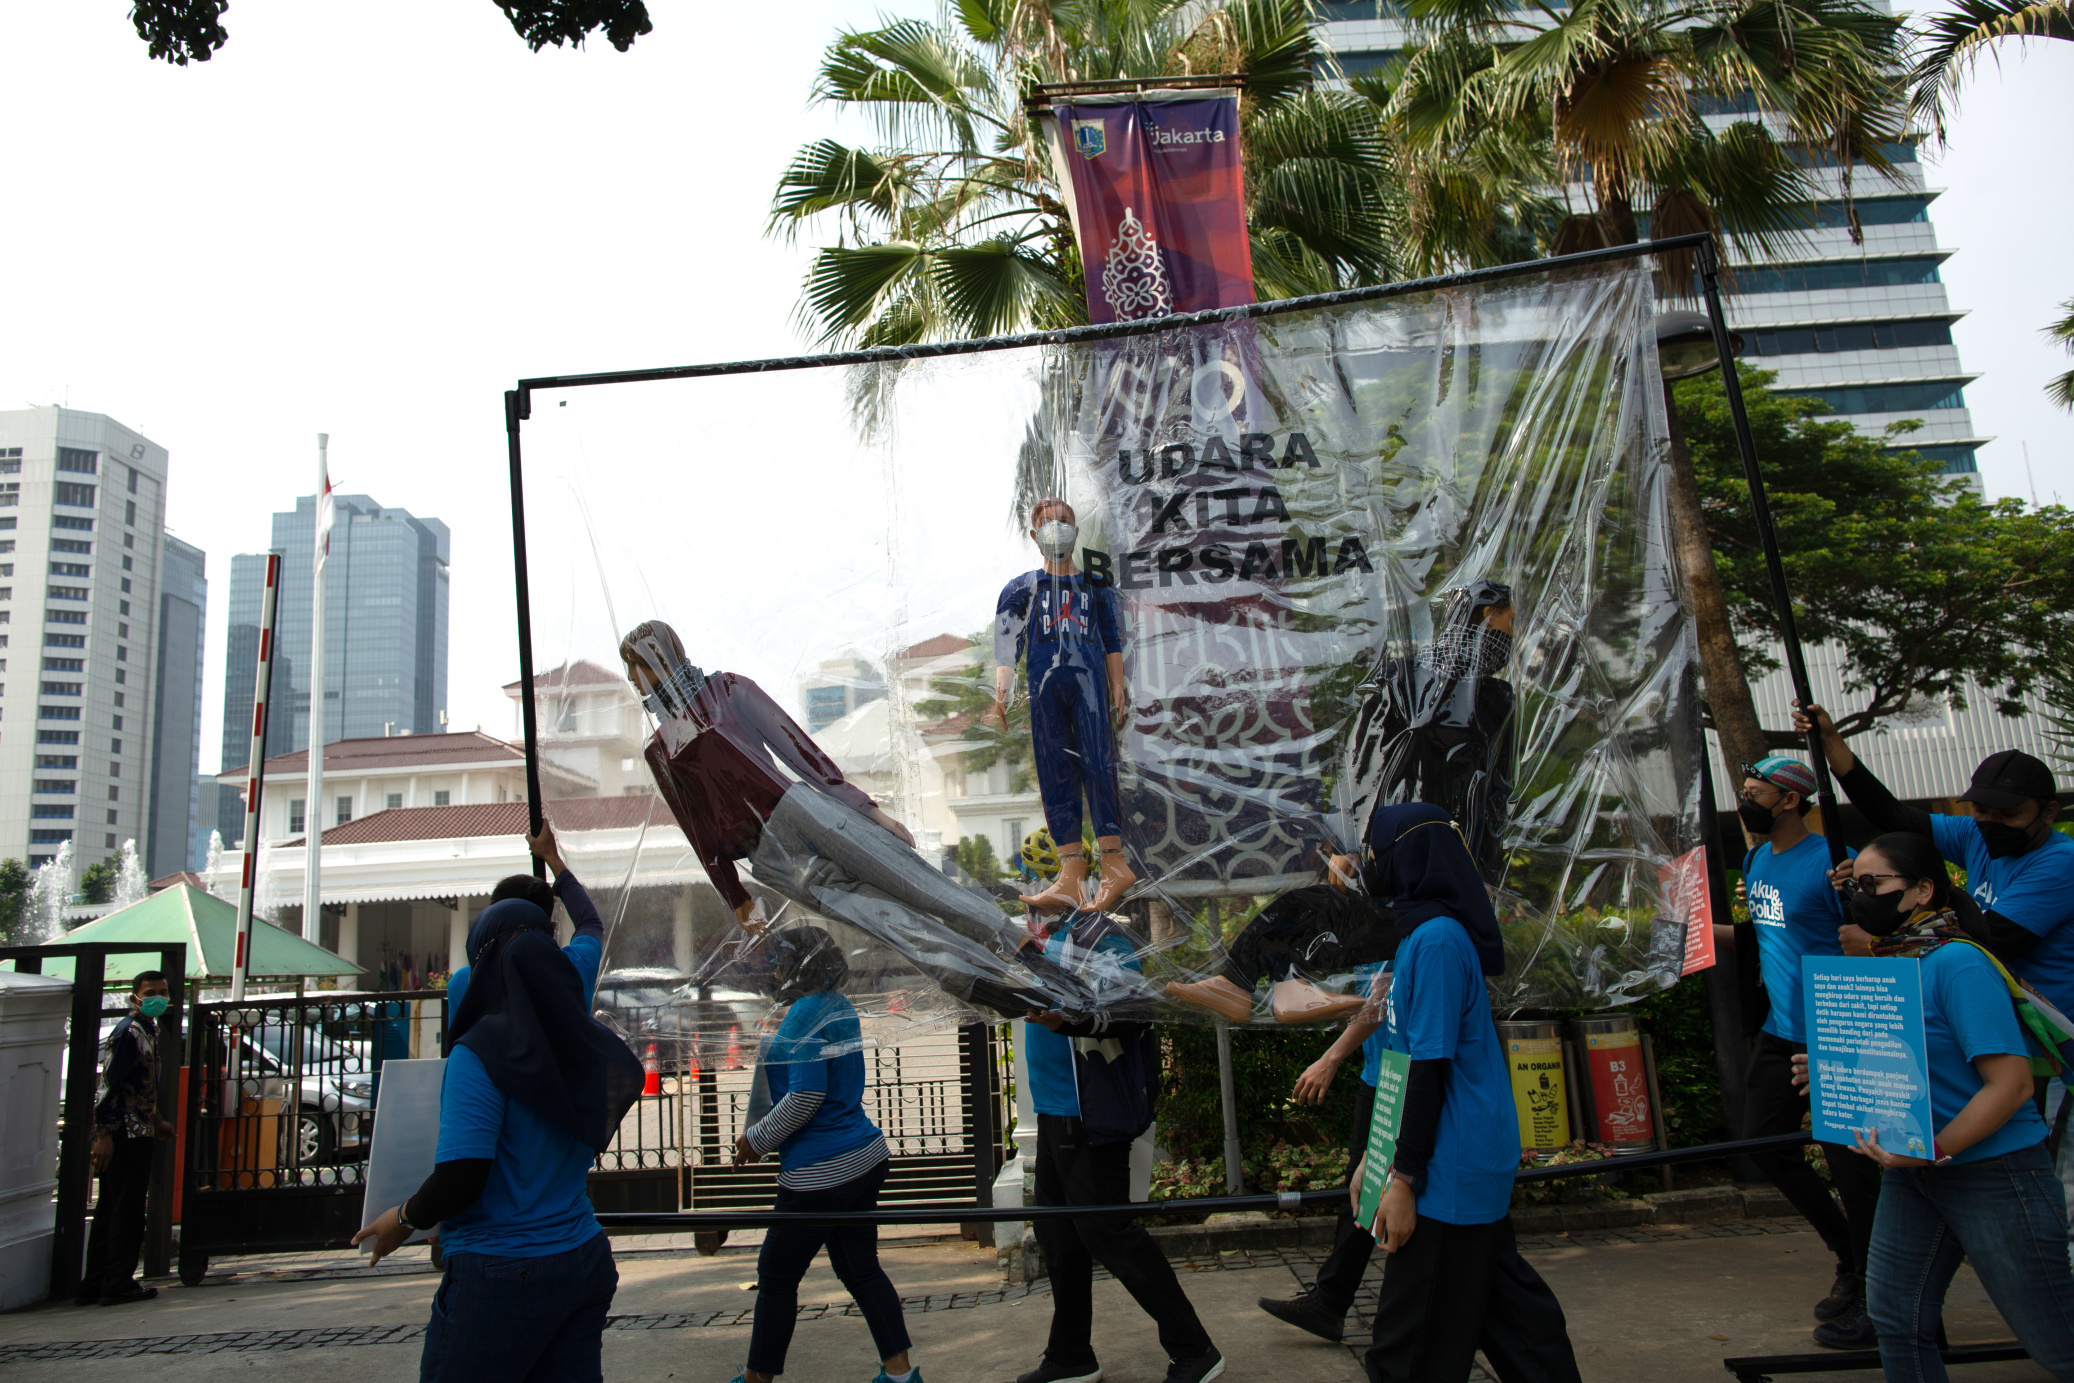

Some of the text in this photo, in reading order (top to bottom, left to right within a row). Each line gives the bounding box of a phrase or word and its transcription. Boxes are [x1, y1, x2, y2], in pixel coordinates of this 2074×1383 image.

[1152, 126, 1225, 145] jakarta
[1119, 432, 1321, 485] UDARA
[1152, 486, 1292, 533] KITA
[1082, 536, 1374, 590] BERSAMA
[1749, 880, 1781, 907] Aku&
[1749, 900, 1785, 921] Polusi
[1814, 973, 1829, 982] Setiap
[1843, 975, 1854, 983] saya
[1856, 975, 1881, 983] berharap
[1815, 992, 1842, 1000] menghirup
[1875, 994, 1892, 1002] bersih
[1816, 1000, 1838, 1008] terbebas
[1851, 1002, 1866, 1010] sakit,
[1868, 1003, 1879, 1011] tapi
[1880, 1004, 1897, 1012] setiap
[1831, 1010, 1852, 1018] harapan
[1868, 1011, 1903, 1021] diruntuhkan
[1817, 1026, 1838, 1034] memilih
[1839, 1028, 1861, 1037] banding
[1855, 1020, 1873, 1028] negara
[1875, 1022, 1888, 1030] yang
[1889, 1022, 1904, 1030] lebih
[1829, 1045, 1855, 1053] kewajiban
[1846, 1038, 1869, 1046] perintah
[1871, 1039, 1902, 1048] pengadilan
[1518, 1062, 1561, 1071] AN ORGANIK
[1610, 1060, 1626, 1072] B3
[1820, 1064, 1909, 1081] Polusi udara berdampak panjang
[1834, 1074, 1861, 1084] kesehatan
[1862, 1078, 1892, 1087] anak-anak
[1893, 1081, 1917, 1091] maupun
[1821, 1083, 1911, 1099] orang dewasa. Penyakit-penyakit
[1821, 1091, 1838, 1099] kronis
[1850, 1094, 1874, 1104] berbagai
[1875, 1096, 1889, 1105] jenis
[1890, 1099, 1911, 1109] kanker
[1822, 1100, 1906, 1118] dapat timbul akibat menghirup
[1822, 1109, 1837, 1117] udara
